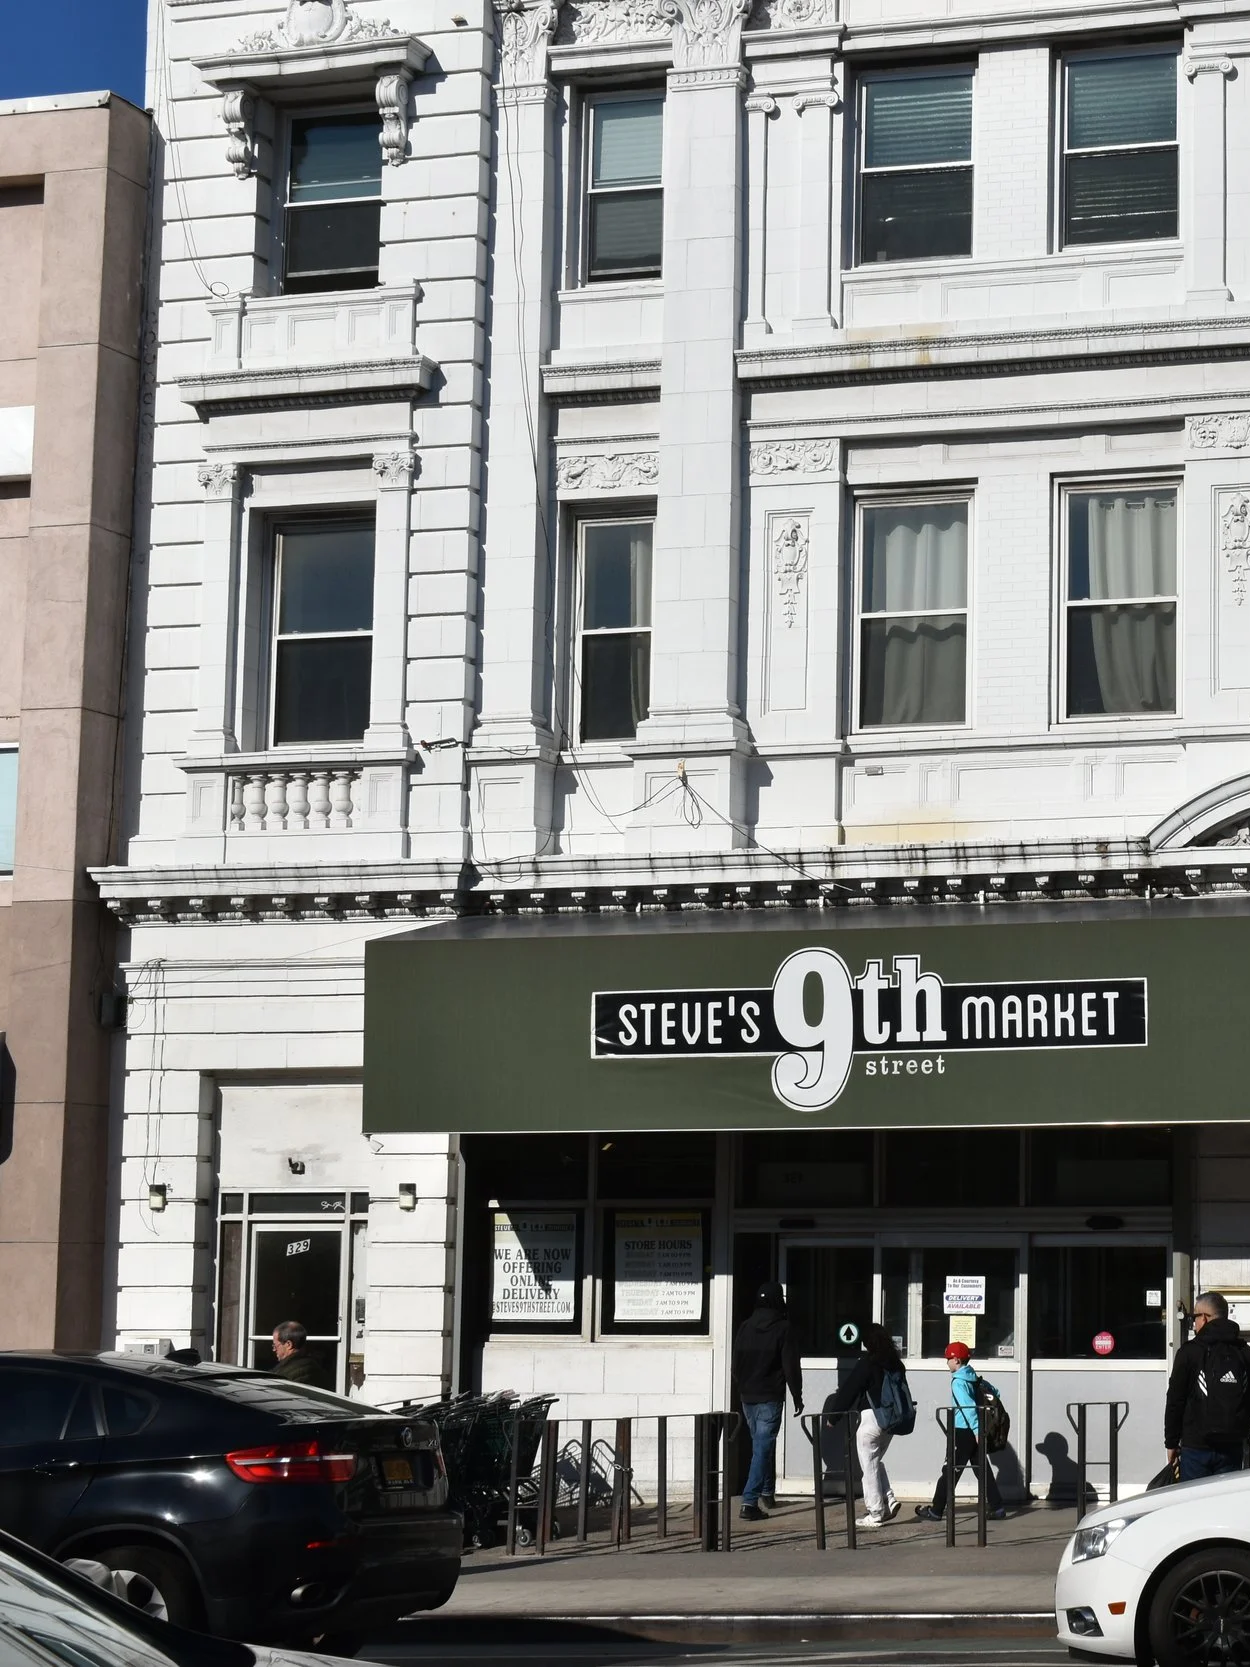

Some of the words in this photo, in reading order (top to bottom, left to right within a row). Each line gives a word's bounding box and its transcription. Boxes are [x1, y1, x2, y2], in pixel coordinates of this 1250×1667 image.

[618, 996, 761, 1046] STEVE'S
[771, 947, 948, 1112] 9th
[961, 991, 1120, 1040] MARKET
[865, 1055, 946, 1076] street
[287, 1240, 309, 1255] 329
[624, 1240, 657, 1250] STORE
[658, 1239, 692, 1250] HOURS
[494, 1248, 512, 1260] WE
[515, 1248, 540, 1260] ARE
[543, 1248, 573, 1261] NOW
[502, 1261, 562, 1274] OFFERING
[510, 1275, 553, 1287] ONLINE
[502, 1288, 560, 1300] DELIVERY
